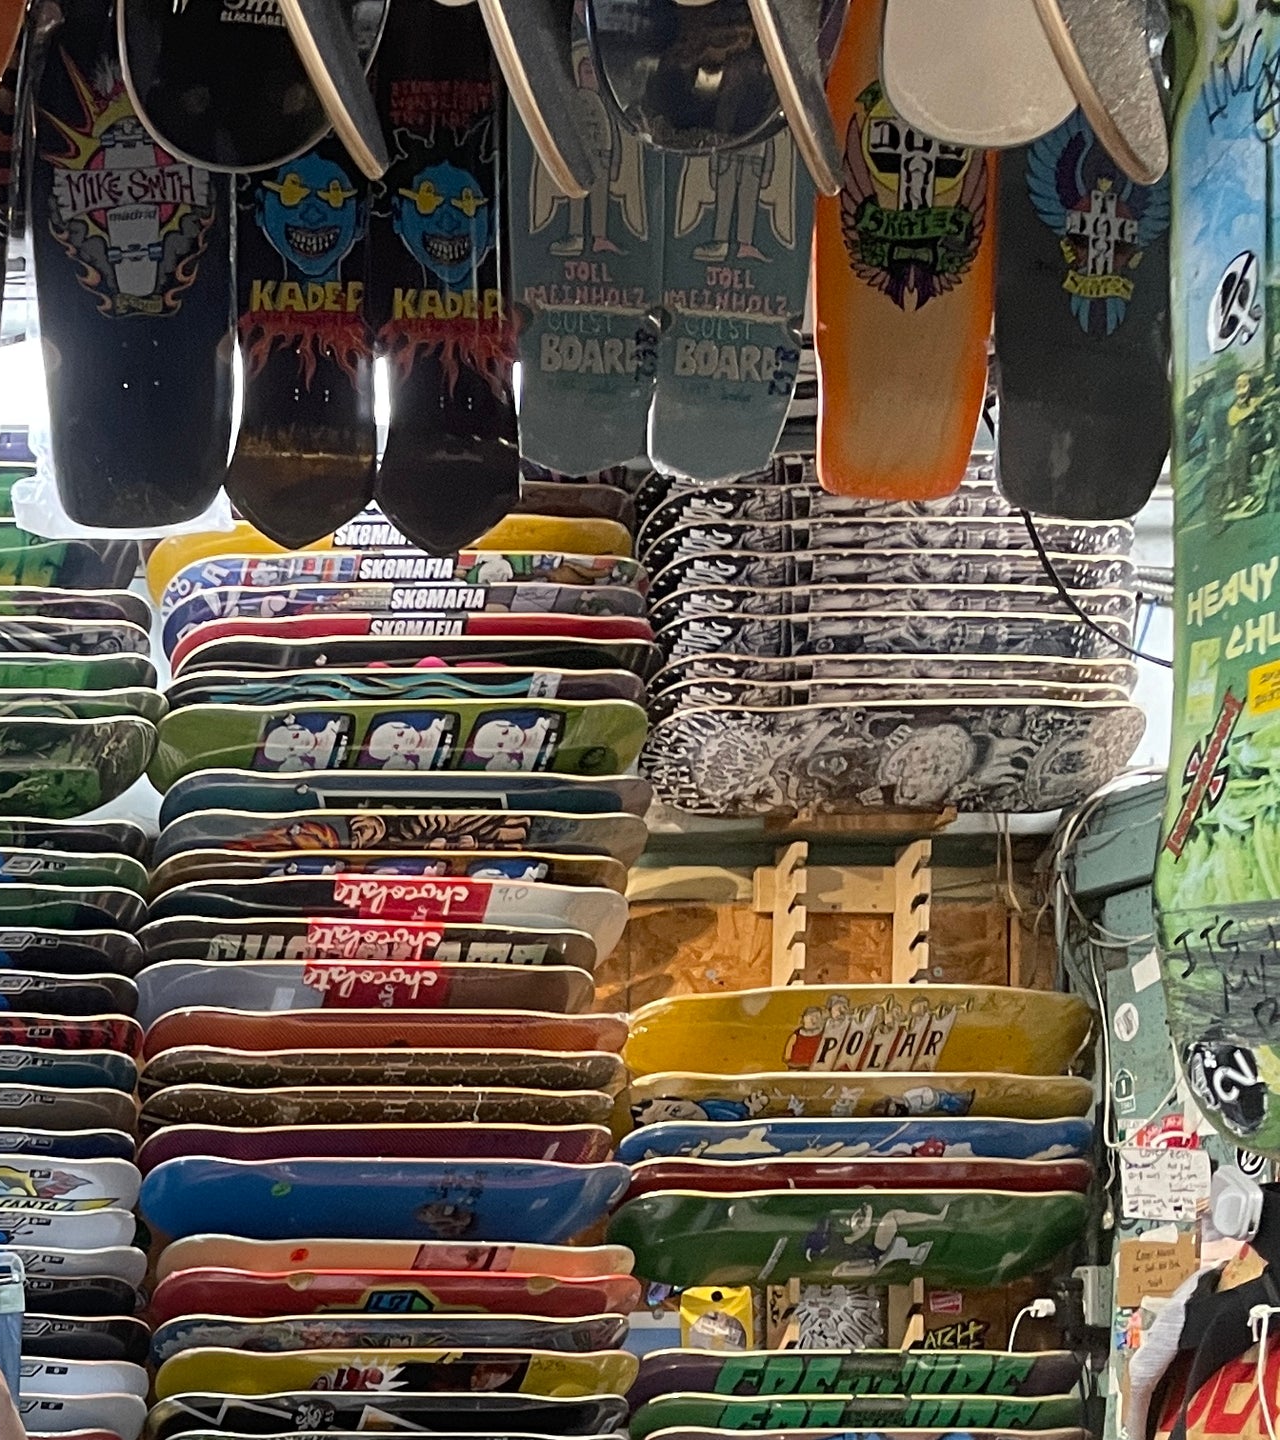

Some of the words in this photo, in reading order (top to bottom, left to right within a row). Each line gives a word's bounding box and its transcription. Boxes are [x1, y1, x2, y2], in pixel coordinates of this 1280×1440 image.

[67, 172, 122, 206] MIKE
[127, 166, 194, 206] SMITH
[707, 267, 755, 289] JOEL
[360, 557, 453, 579] SK8MAFIA
[392, 588, 484, 610] SK8MAFIA
[336, 880, 468, 915] chocolate
[308, 925, 441, 960] chocolate
[304, 967, 438, 999] chocolate
[817, 1027, 944, 1069] POLAR
